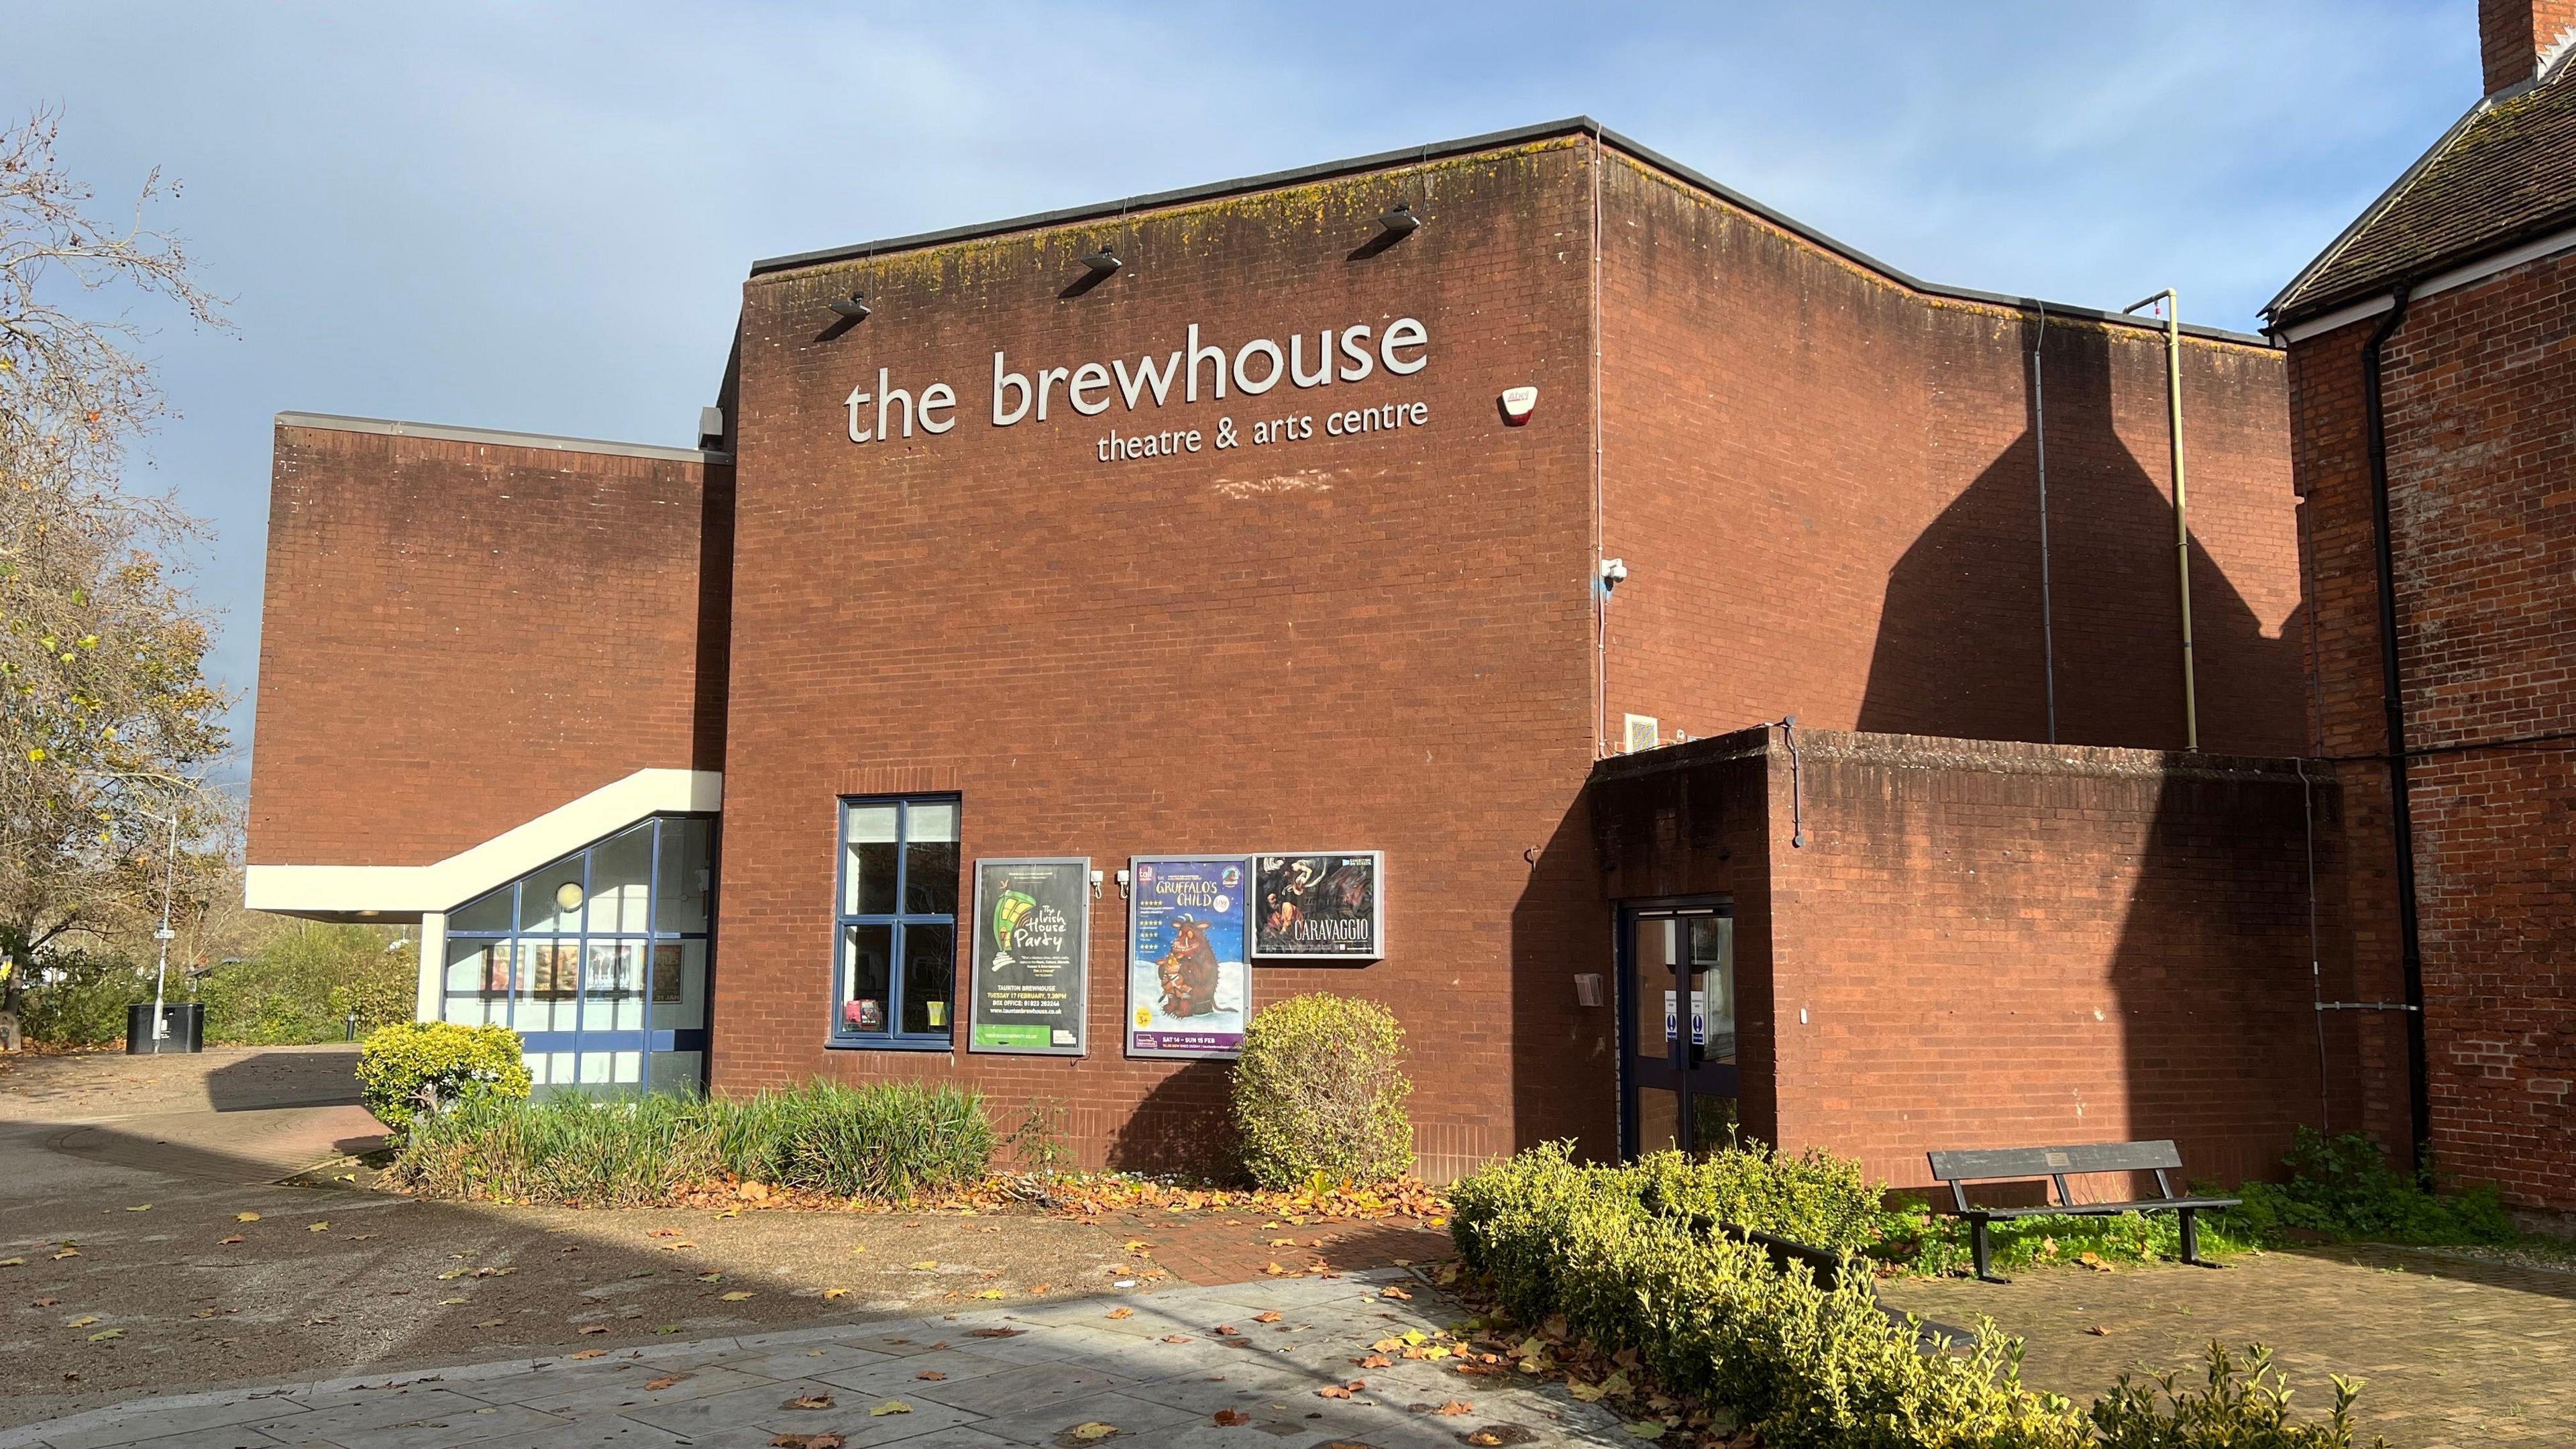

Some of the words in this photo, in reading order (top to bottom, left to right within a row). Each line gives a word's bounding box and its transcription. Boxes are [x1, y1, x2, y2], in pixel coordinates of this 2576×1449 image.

[843, 366, 957, 443] the
[992, 317, 1429, 426] brewhouse
[1097, 429, 1201, 462] theatre
[1216, 417, 1239, 449] &
[1254, 414, 1313, 444] arts
[1327, 401, 1428, 435] centre
[1156, 880, 1218, 894] GRUFFALO'S
[1177, 893, 1212, 906] CHILD
[1042, 905, 1055, 913] The
[1025, 917, 1067, 932] House
[1039, 910, 1067, 925] Irish
[1294, 918, 1368, 941] CARAVAGGIO
[1014, 928, 1063, 952] Party
